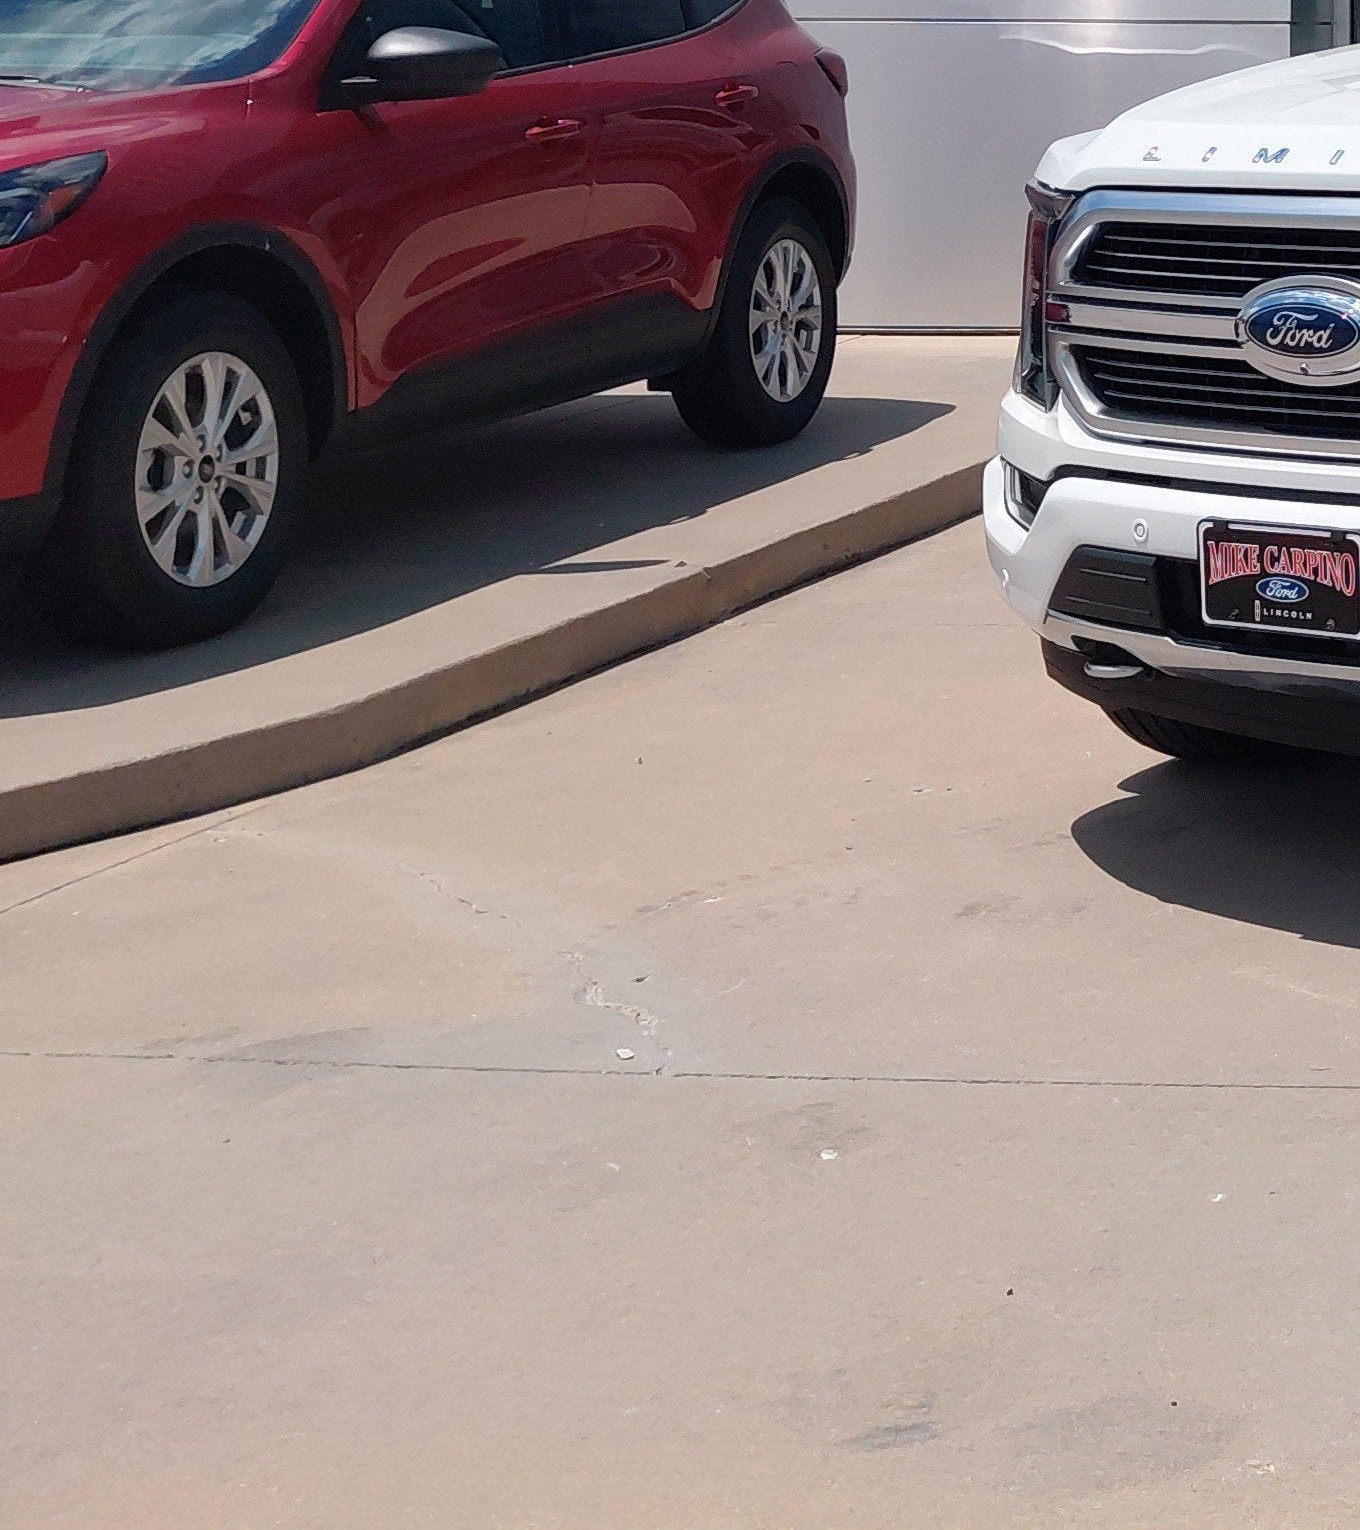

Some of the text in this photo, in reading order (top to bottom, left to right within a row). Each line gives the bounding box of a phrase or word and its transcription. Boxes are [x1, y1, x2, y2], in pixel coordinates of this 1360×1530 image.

[1265, 311, 1335, 349] Ford
[1207, 540, 1356, 597] MIKE CARPINO
[1265, 580, 1299, 599] Ford
[1262, 607, 1313, 620] LINCOLN
